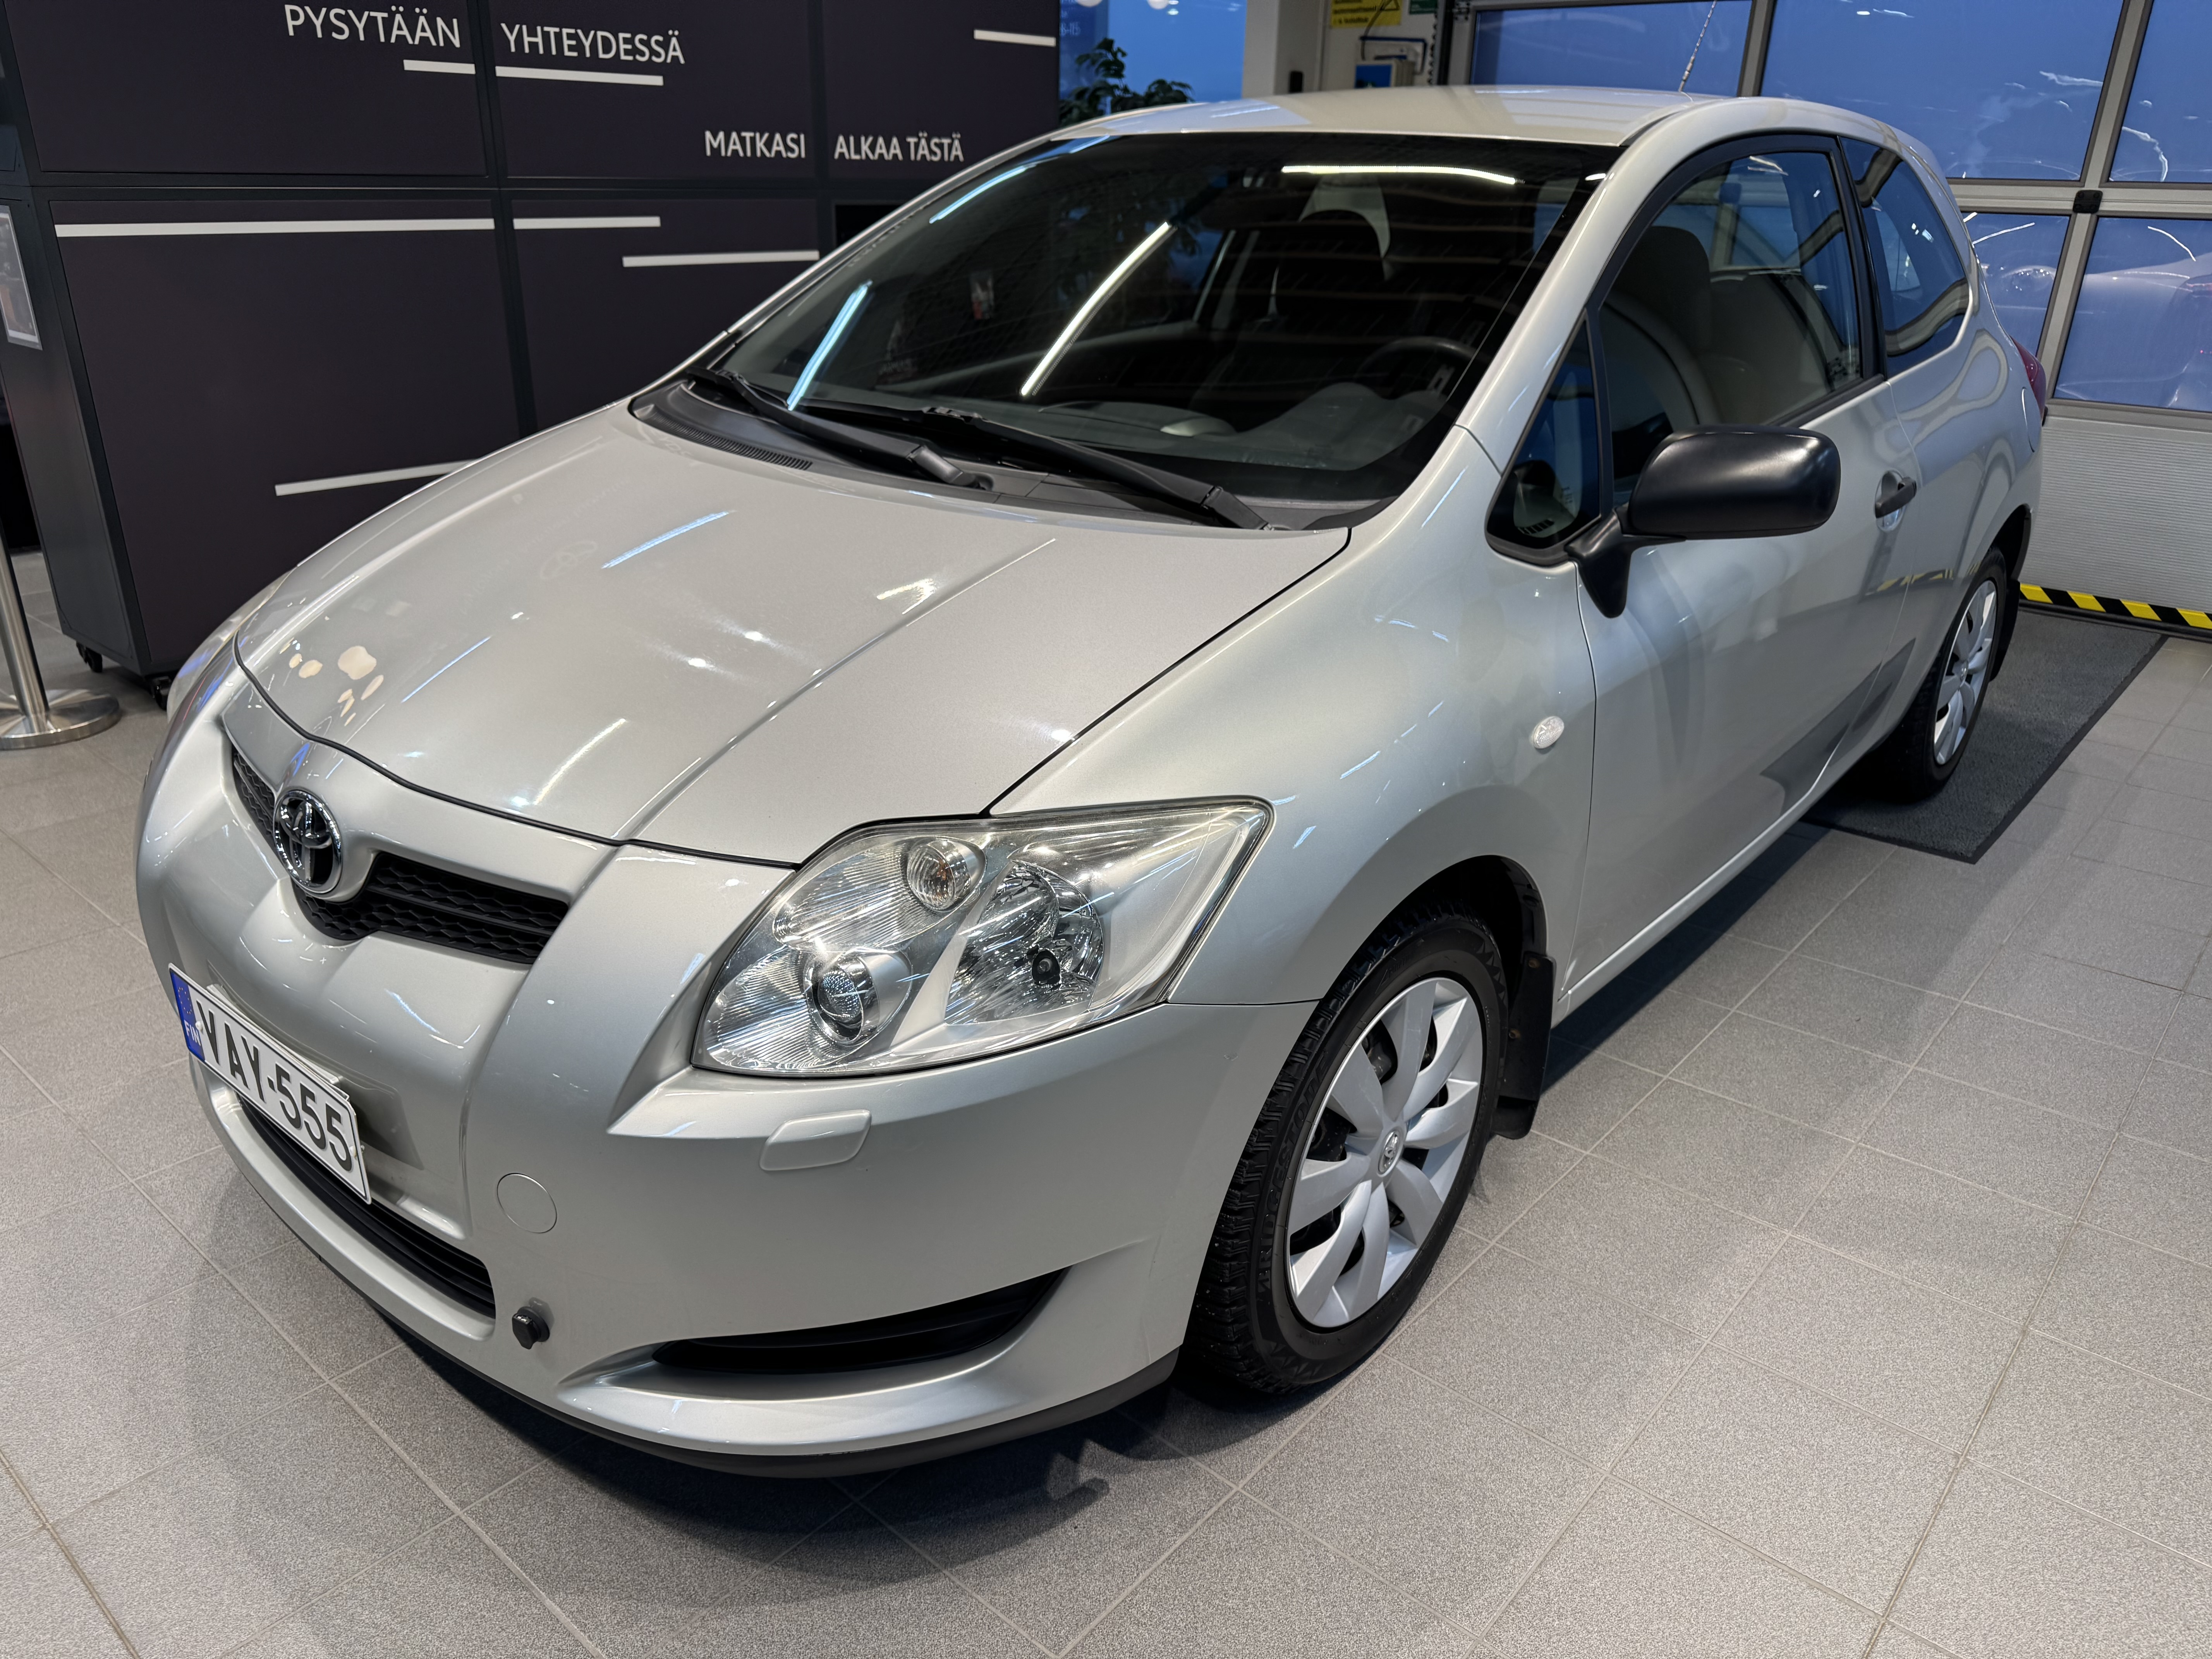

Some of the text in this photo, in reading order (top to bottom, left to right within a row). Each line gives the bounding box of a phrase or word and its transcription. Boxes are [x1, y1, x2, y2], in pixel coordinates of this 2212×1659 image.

[284, 4, 685, 64] PYSYTÄÄN YHTEYDESSÄ
[704, 131, 964, 161] MATKASI ALKAA TÄSTÄ
[184, 1020, 201, 1046] FIN
[196, 1000, 352, 1171] VAY-555
